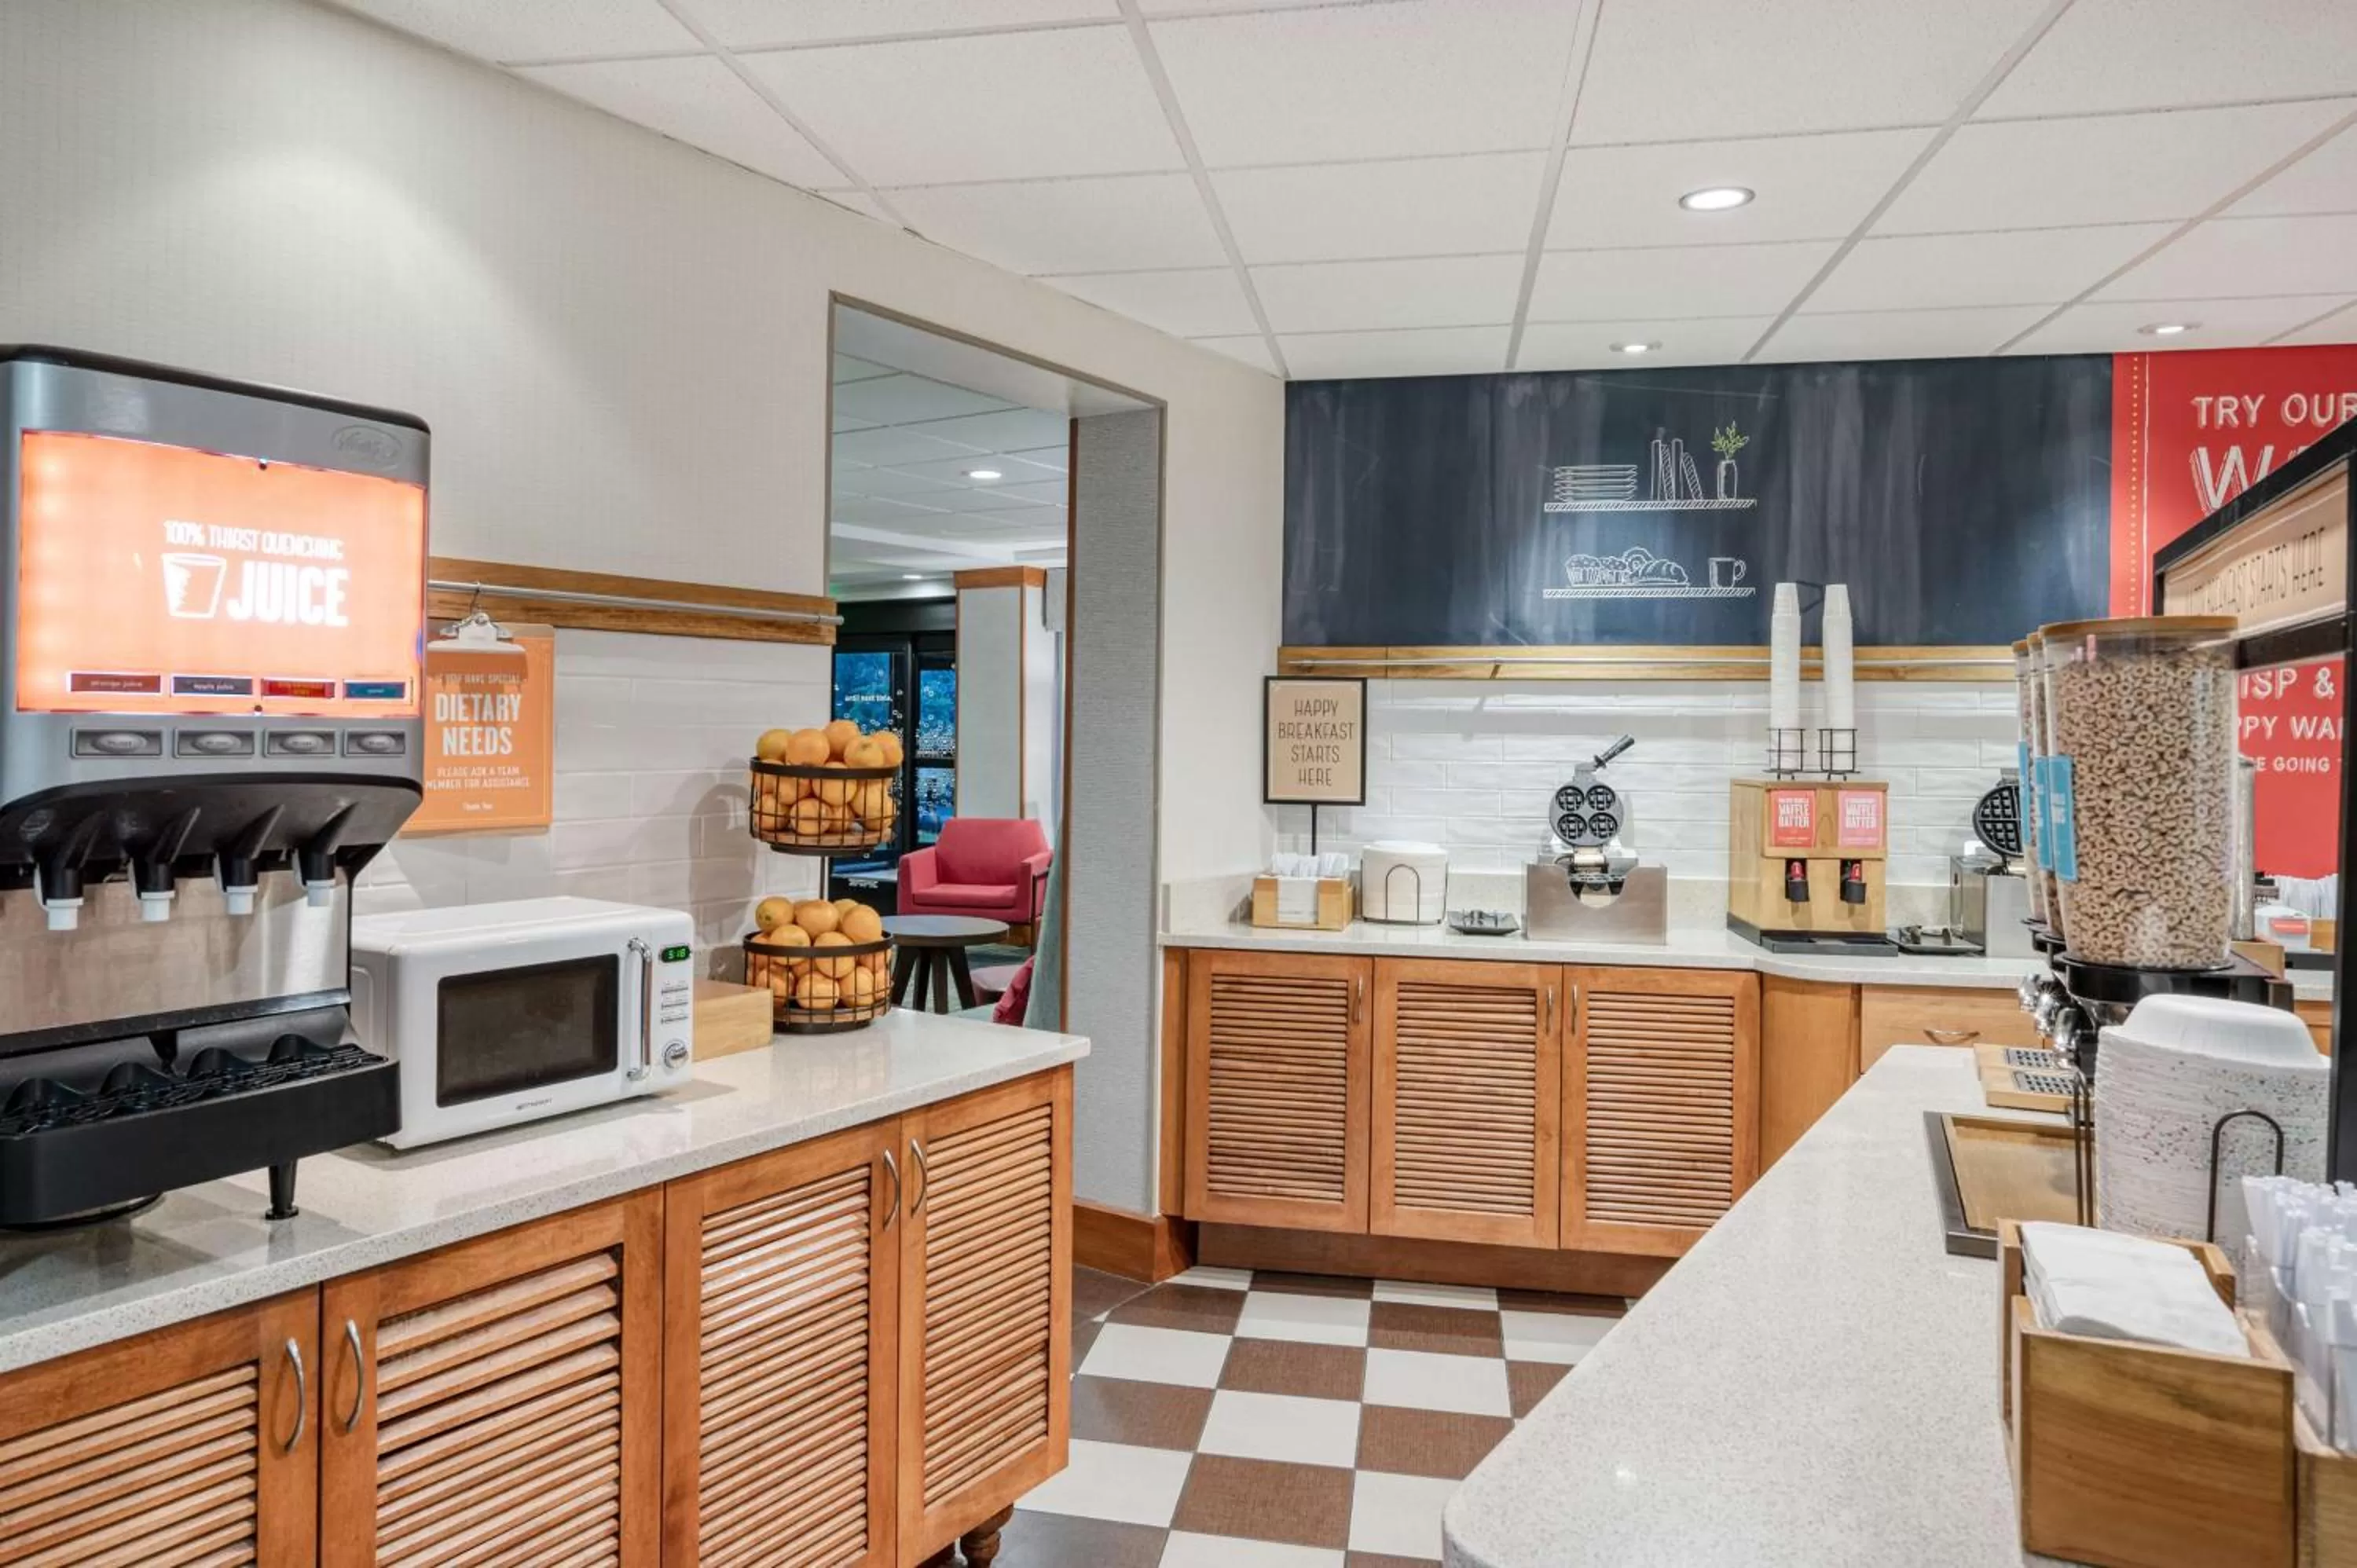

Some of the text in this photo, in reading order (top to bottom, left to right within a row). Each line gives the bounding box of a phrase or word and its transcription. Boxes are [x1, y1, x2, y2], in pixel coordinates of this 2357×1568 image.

[2190, 394, 2265, 430] TRY
[163, 519, 344, 559] 100% THIRST QUENCHING
[2292, 526, 2326, 596] HERE
[225, 559, 349, 627] JUICE
[2239, 665, 2336, 701] ISP &
[434, 692, 522, 723] DIETARY
[1293, 698, 1339, 717] HAPPY
[442, 726, 513, 756] NEEDS
[1277, 721, 1355, 740] BREAKFAST
[1291, 744, 1340, 764] STARTS
[2272, 756, 2331, 773] GOING
[1298, 767, 1333, 786] HERE
